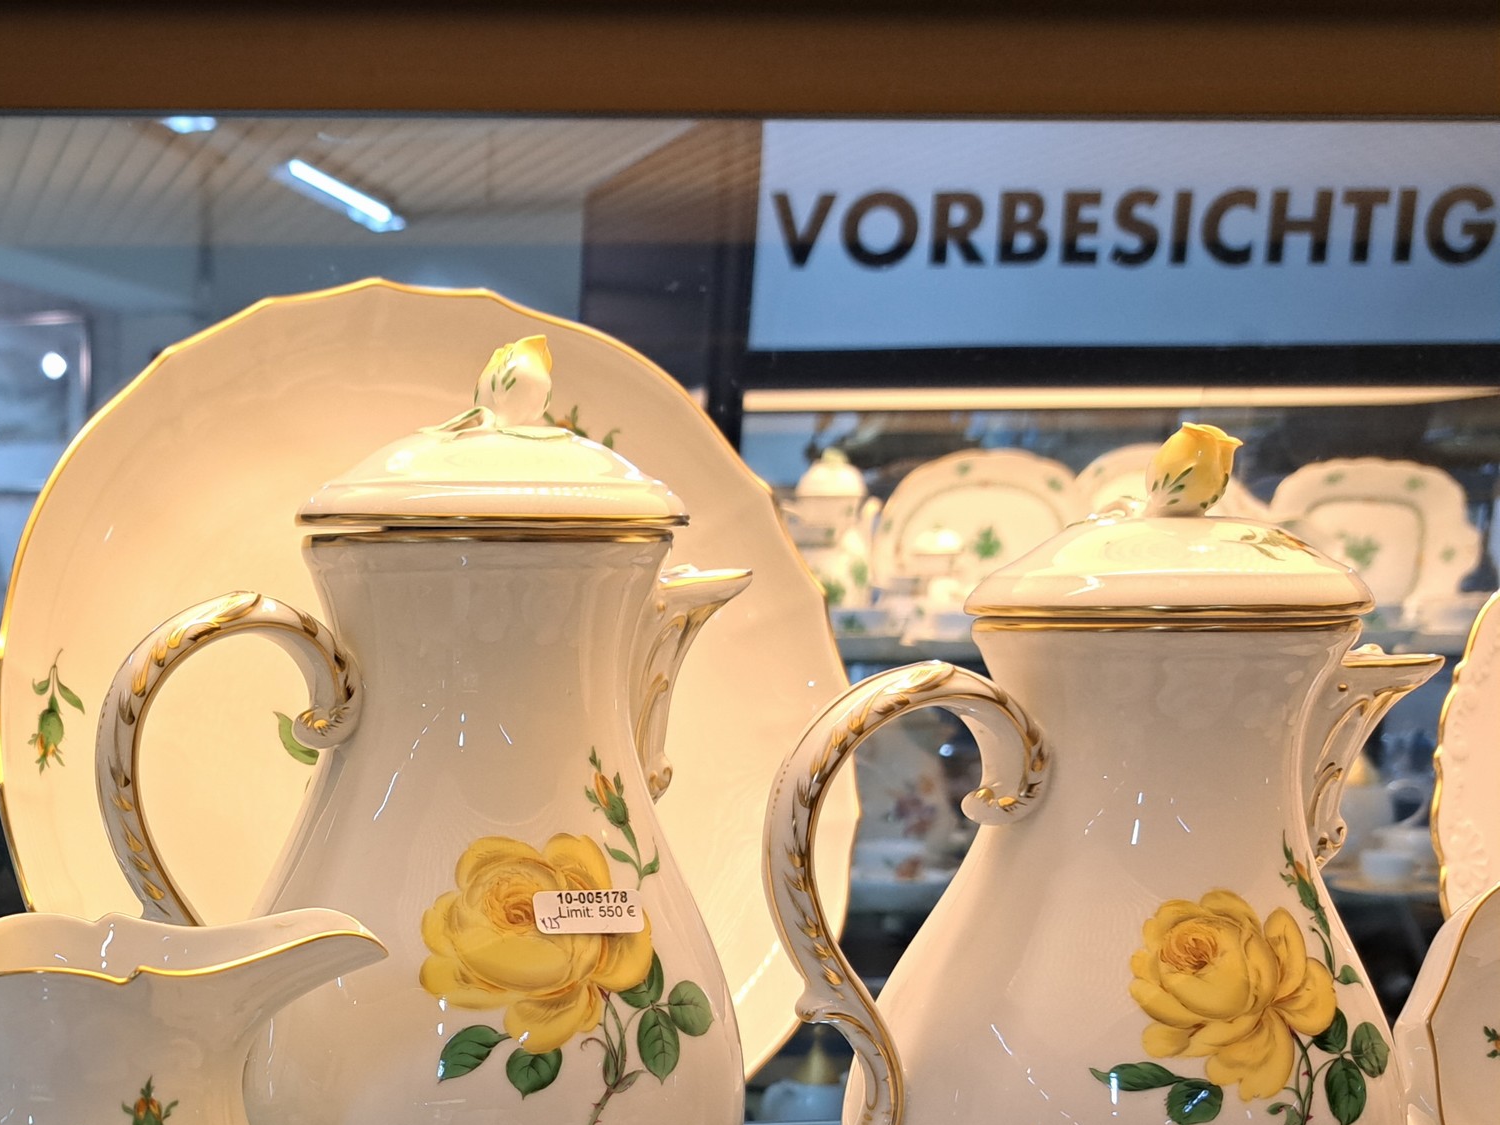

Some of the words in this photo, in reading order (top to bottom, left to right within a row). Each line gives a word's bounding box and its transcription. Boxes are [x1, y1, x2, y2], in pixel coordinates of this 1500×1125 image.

[772, 186, 1497, 268] VORBESICHTIG
[556, 891, 628, 904] 10-005178
[558, 905, 594, 919] Limit:
[598, 905, 623, 918] 550
[626, 905, 636, 917] €
